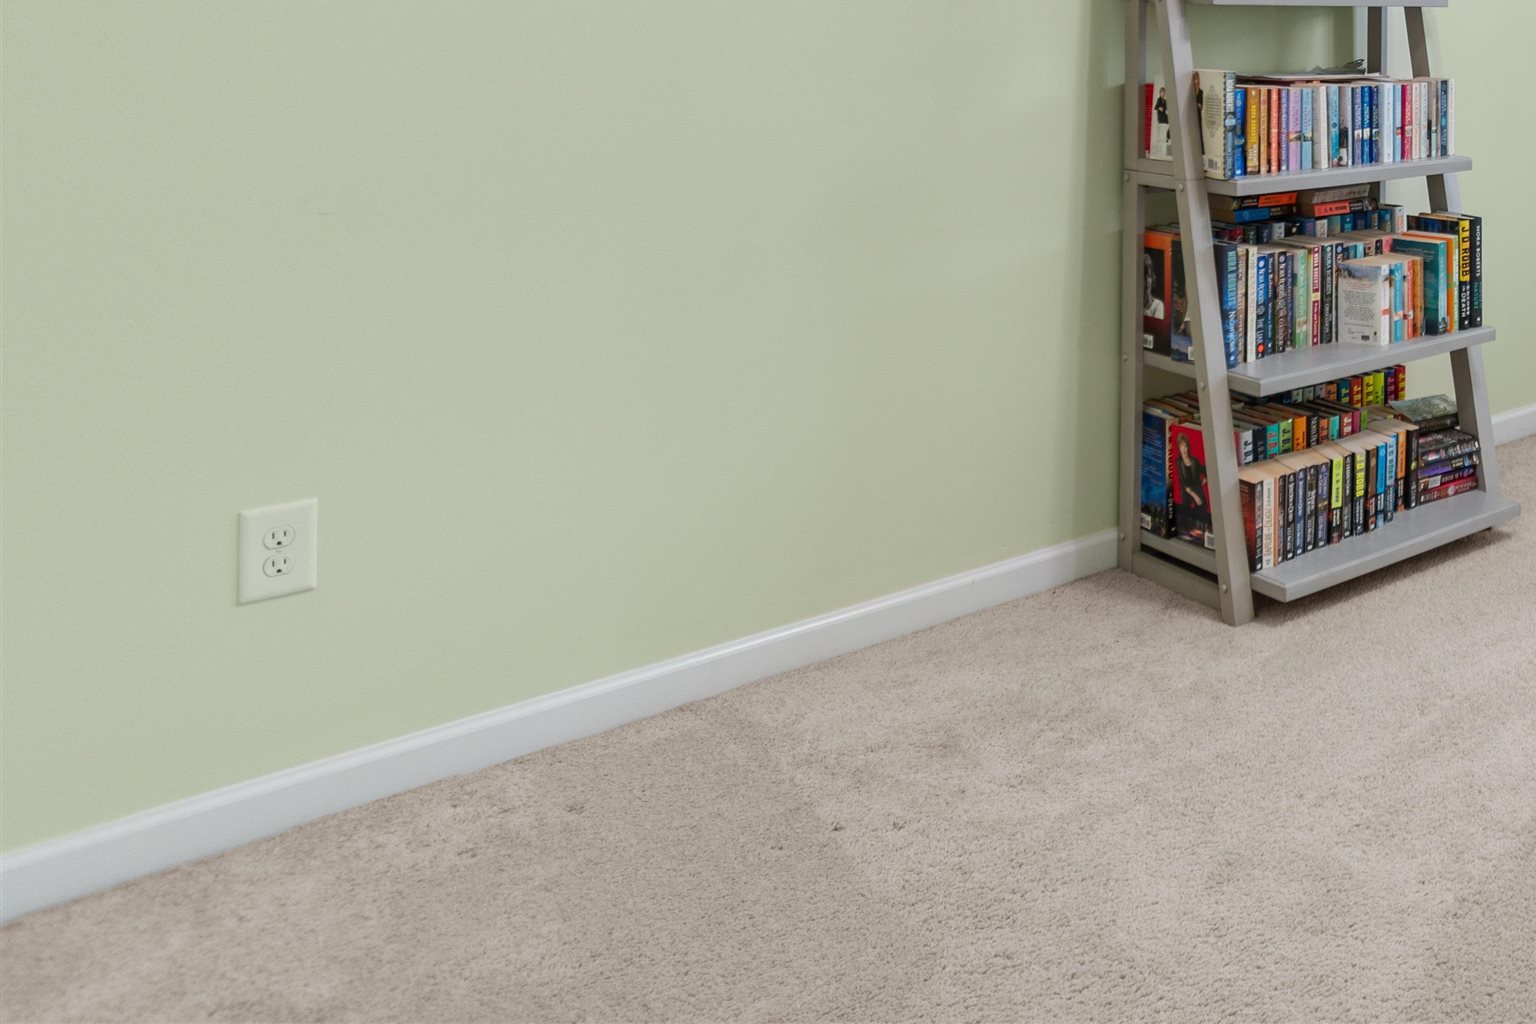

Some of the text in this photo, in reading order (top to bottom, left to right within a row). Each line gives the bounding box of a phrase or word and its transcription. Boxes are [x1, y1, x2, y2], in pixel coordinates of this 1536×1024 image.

[1461, 247, 1470, 277] ROBB
[1228, 251, 1236, 306] NORA ROBERTS
[1257, 283, 1265, 304] ROBERTS
[1356, 472, 1364, 497] ROBB
